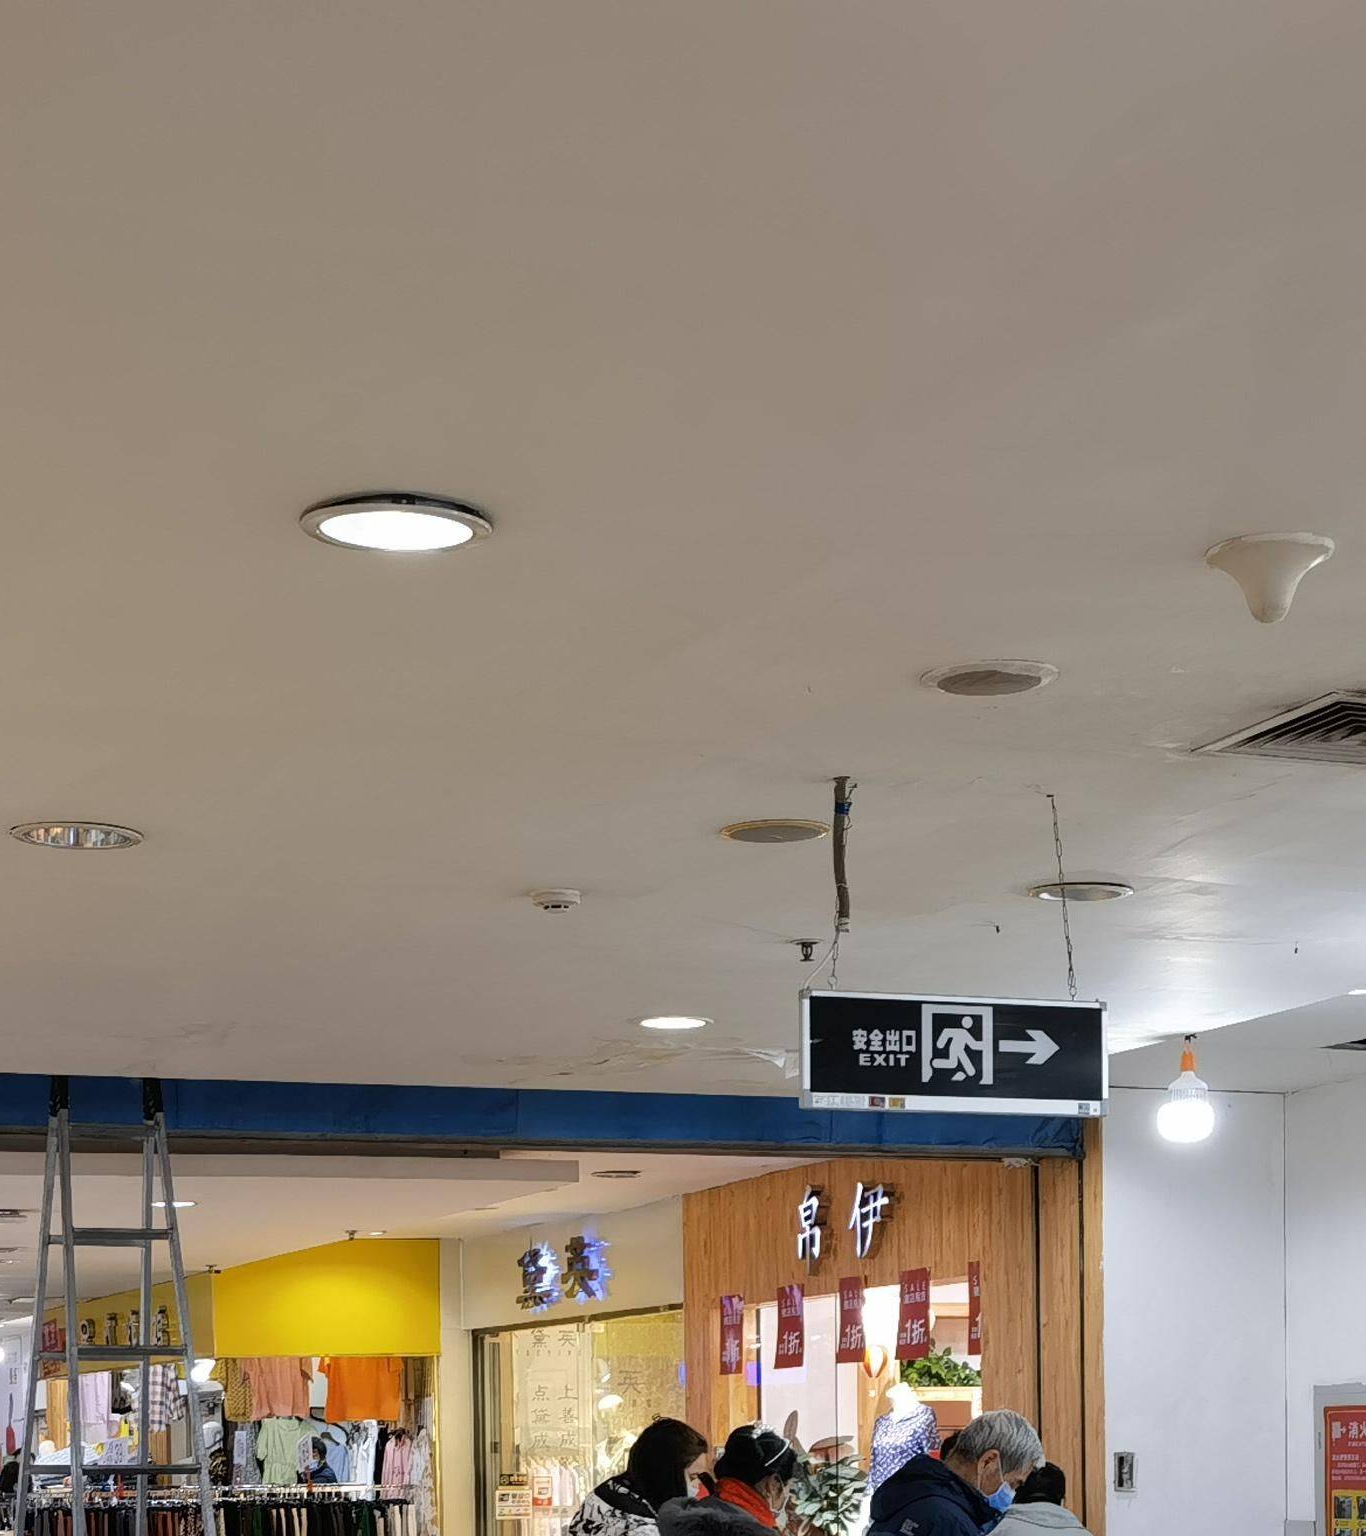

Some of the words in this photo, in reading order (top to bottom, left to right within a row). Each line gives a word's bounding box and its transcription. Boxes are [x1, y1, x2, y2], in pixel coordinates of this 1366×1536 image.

[851, 1028, 917, 1052] 安全出口
[859, 1053, 910, 1067] EXIT
[797, 1181, 890, 1268] 帛伊
